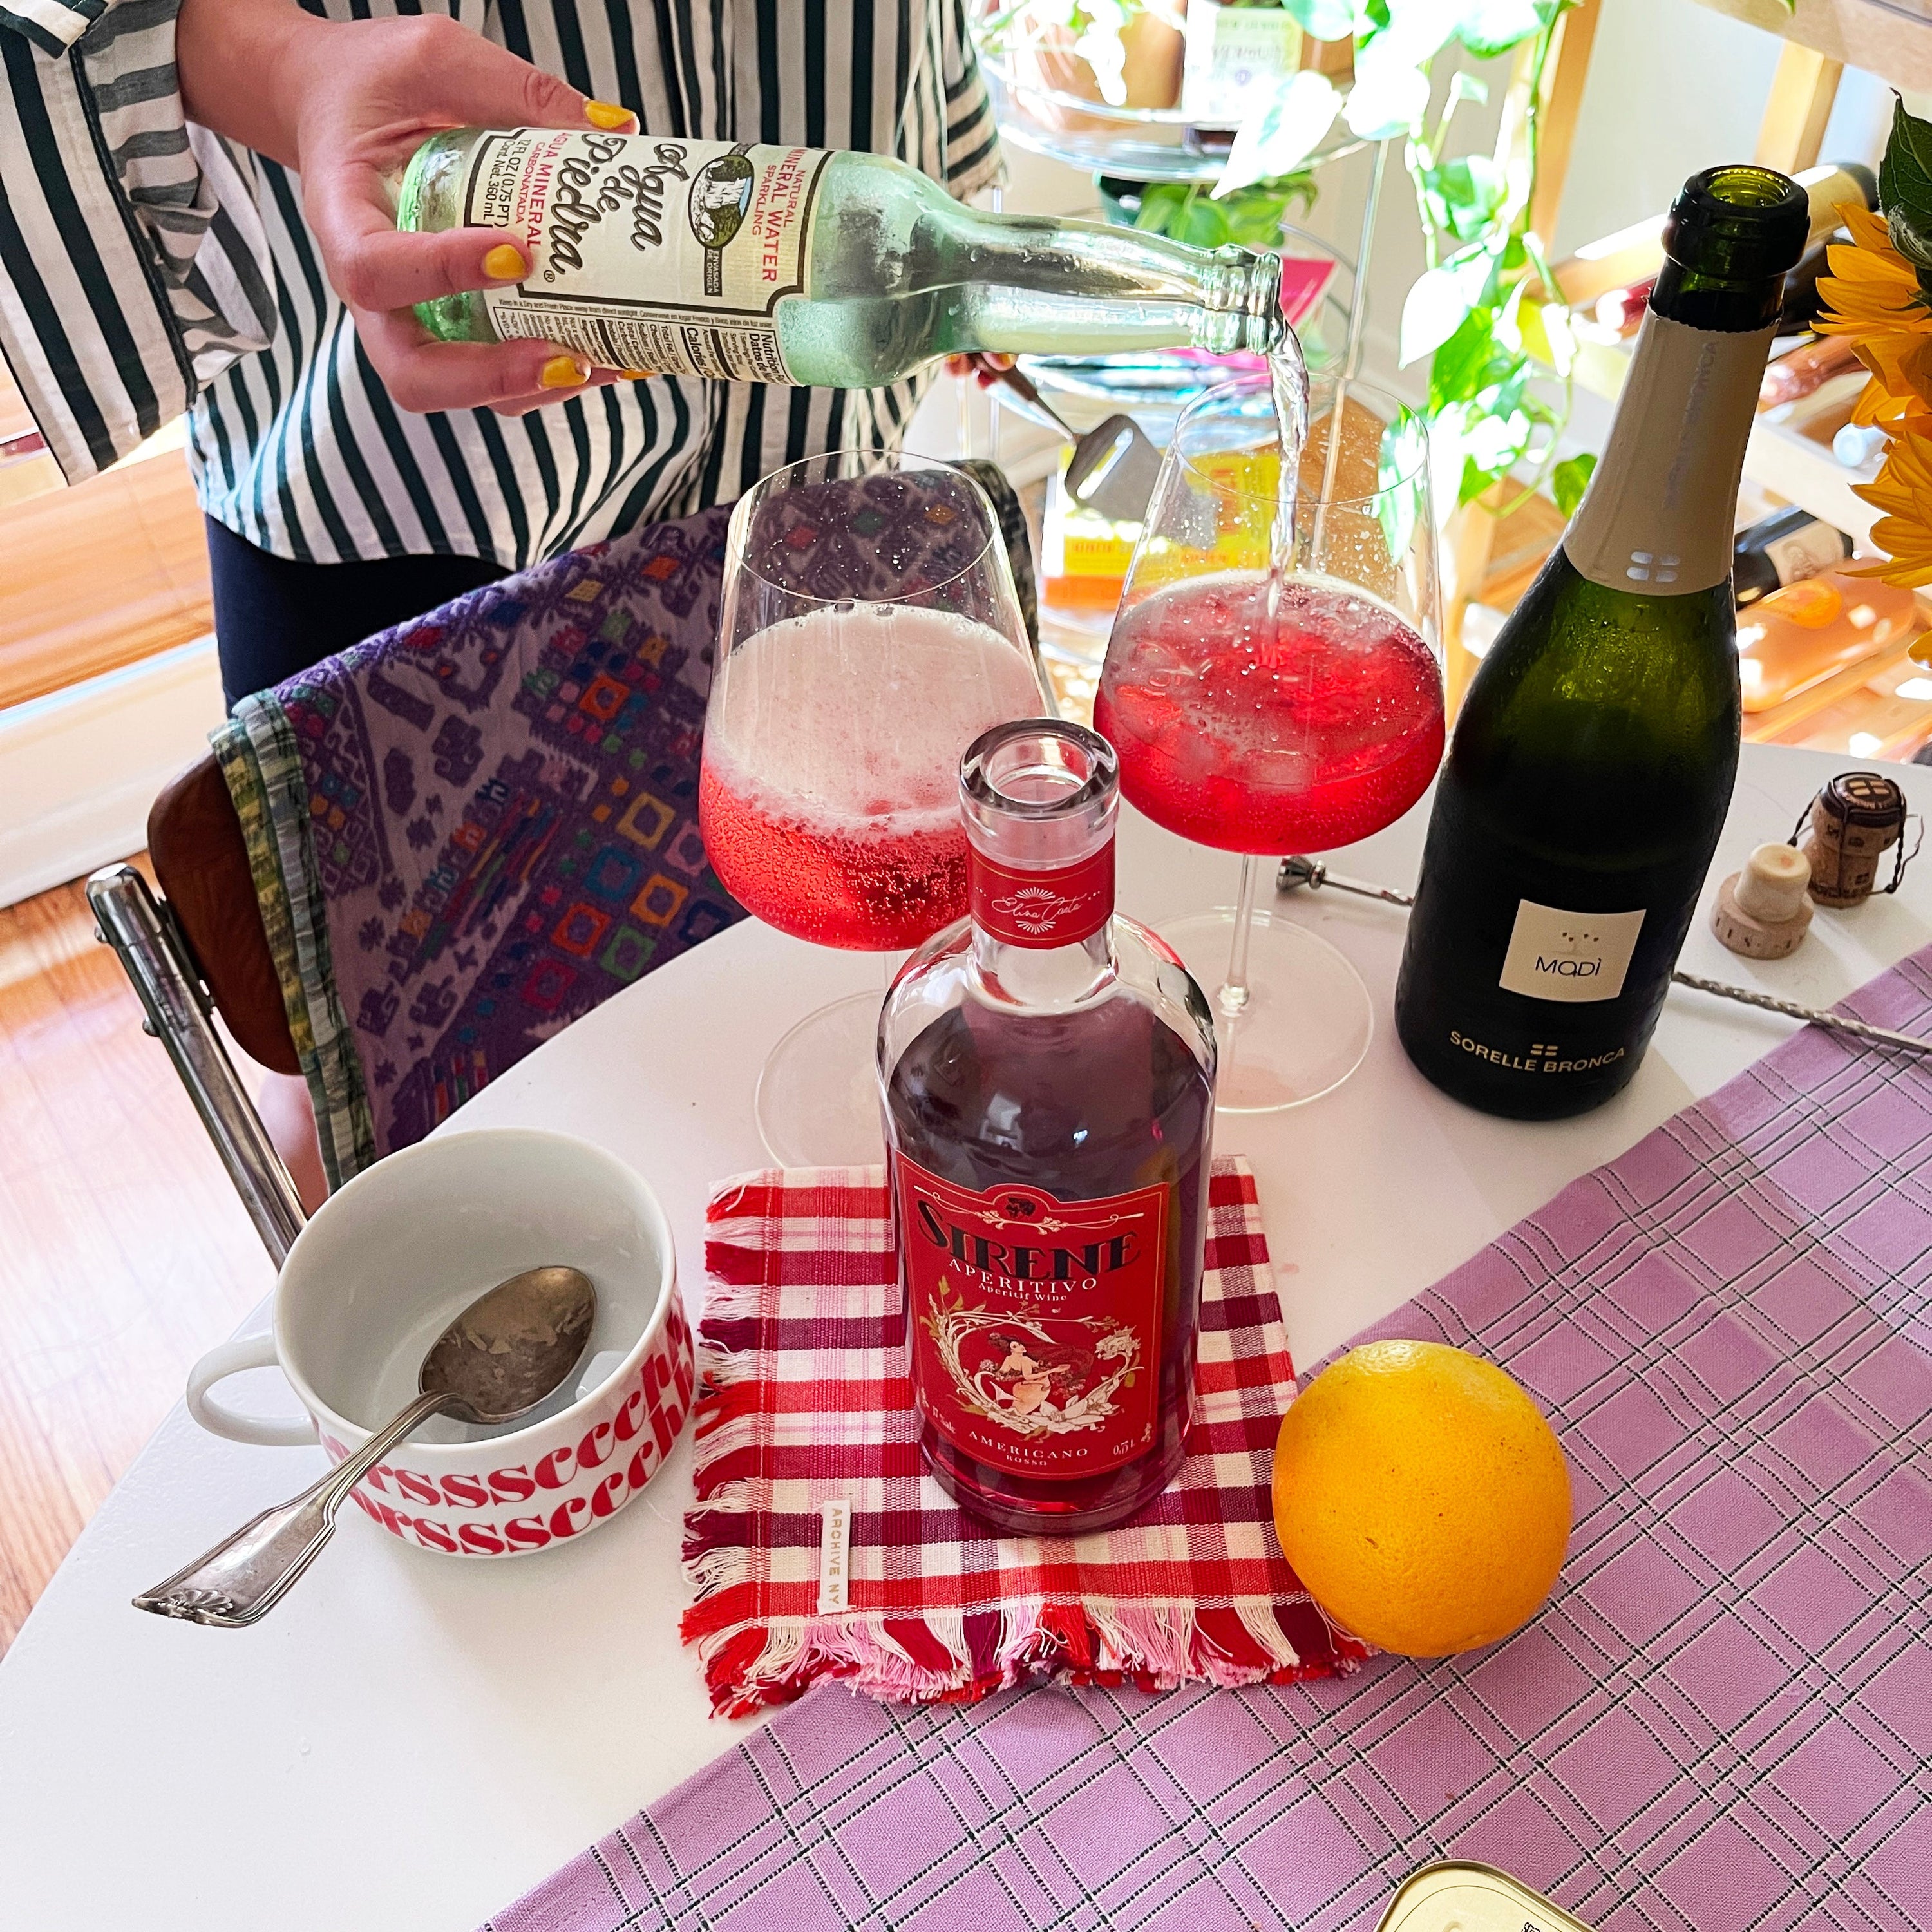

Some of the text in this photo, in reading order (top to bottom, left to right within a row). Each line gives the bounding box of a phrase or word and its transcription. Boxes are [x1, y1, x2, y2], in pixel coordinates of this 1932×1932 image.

[506, 158, 521, 173] OZ
[512, 146, 527, 156] FL
[485, 180, 499, 202] 360
[516, 142, 545, 224] CARBONATADA
[527, 132, 572, 248] AGUA MINERAL
[597, 176, 634, 214] de
[618, 143, 690, 251] Agua
[752, 165, 776, 236] SPARKLING
[784, 169, 806, 227] NATURAL
[483, 202, 495, 221] mL
[762, 149, 808, 282] MINERAL WATER
[687, 328, 707, 366] Calories
[749, 333, 762, 361] Datos
[761, 334, 779, 375] Nutrition
[1450, 1030, 1625, 1073] SORELLE BRONCA
[918, 1199, 1142, 1281] SIRENE
[949, 1258, 1097, 1294] APERITIVO
[969, 1430, 1088, 1459] AMERICANO
[1006, 1454, 1048, 1466] ROSSO
[828, 1508, 843, 1605] ARCHIVE NY
